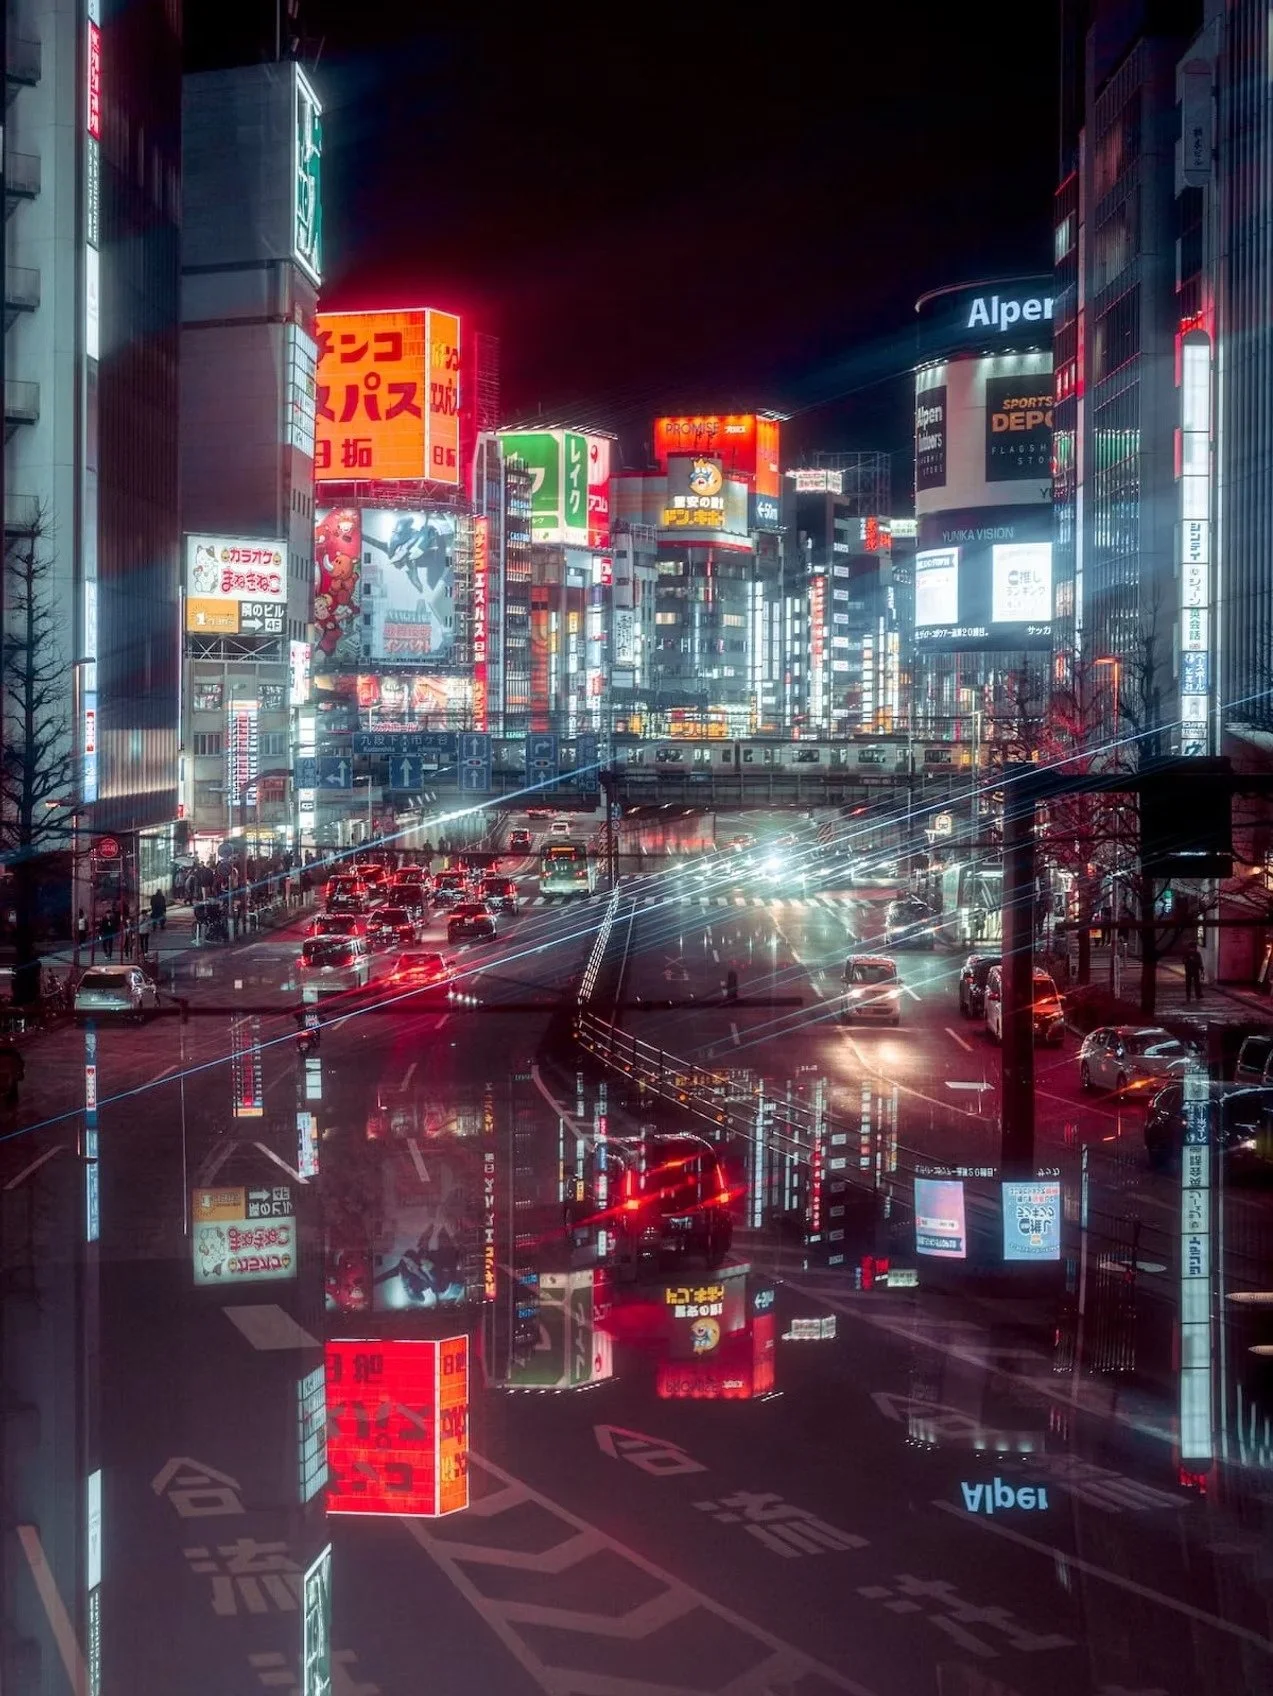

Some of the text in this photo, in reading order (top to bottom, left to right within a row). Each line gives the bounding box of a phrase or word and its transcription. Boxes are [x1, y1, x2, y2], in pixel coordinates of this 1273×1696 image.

[665, 421, 719, 434] PROMISE
[570, 439, 581, 514] レイク
[976, 527, 1014, 540] VISION
[230, 548, 273, 564] カラオケ
[221, 570, 280, 593] まねきねこ
[1189, 578, 1201, 606] シェーン
[242, 603, 284, 618] 隣のビル
[266, 619, 281, 631] 4F
[1189, 609, 1201, 640] 英会話
[361, 735, 399, 745] 九段下
